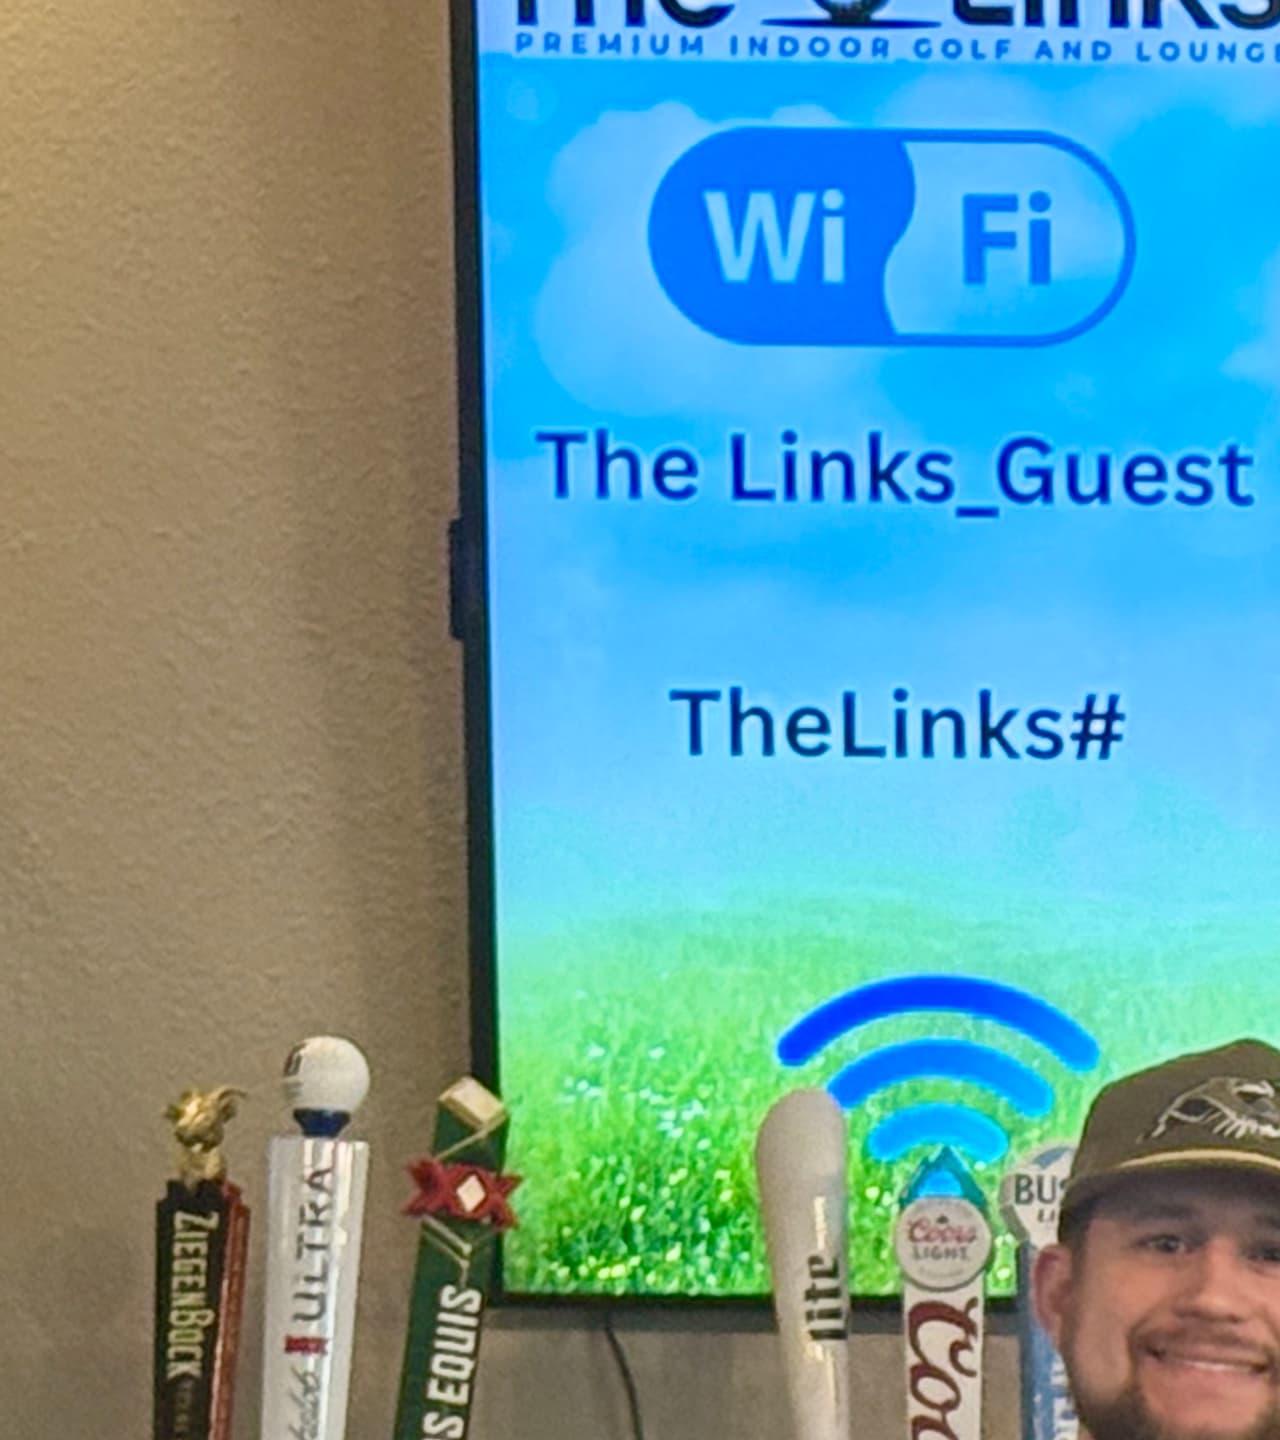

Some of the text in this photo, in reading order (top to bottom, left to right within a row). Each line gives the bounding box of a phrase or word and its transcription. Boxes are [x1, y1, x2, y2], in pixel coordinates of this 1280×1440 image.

[515, 32, 704, 56] PREMIUM
[729, 35, 890, 59] INDOOR
[913, 37, 1012, 61] GOLF
[1034, 39, 1113, 62] AND
[703, 188, 1053, 287] Wi Fi
[534, 429, 1257, 519] The Links_Guest
[669, 687, 1127, 762] TheLinks#
[293, 1166, 335, 1323] ULTRA
[911, 1245, 970, 1261] LIGHT
[426, 1284, 483, 1406] EQUIS
